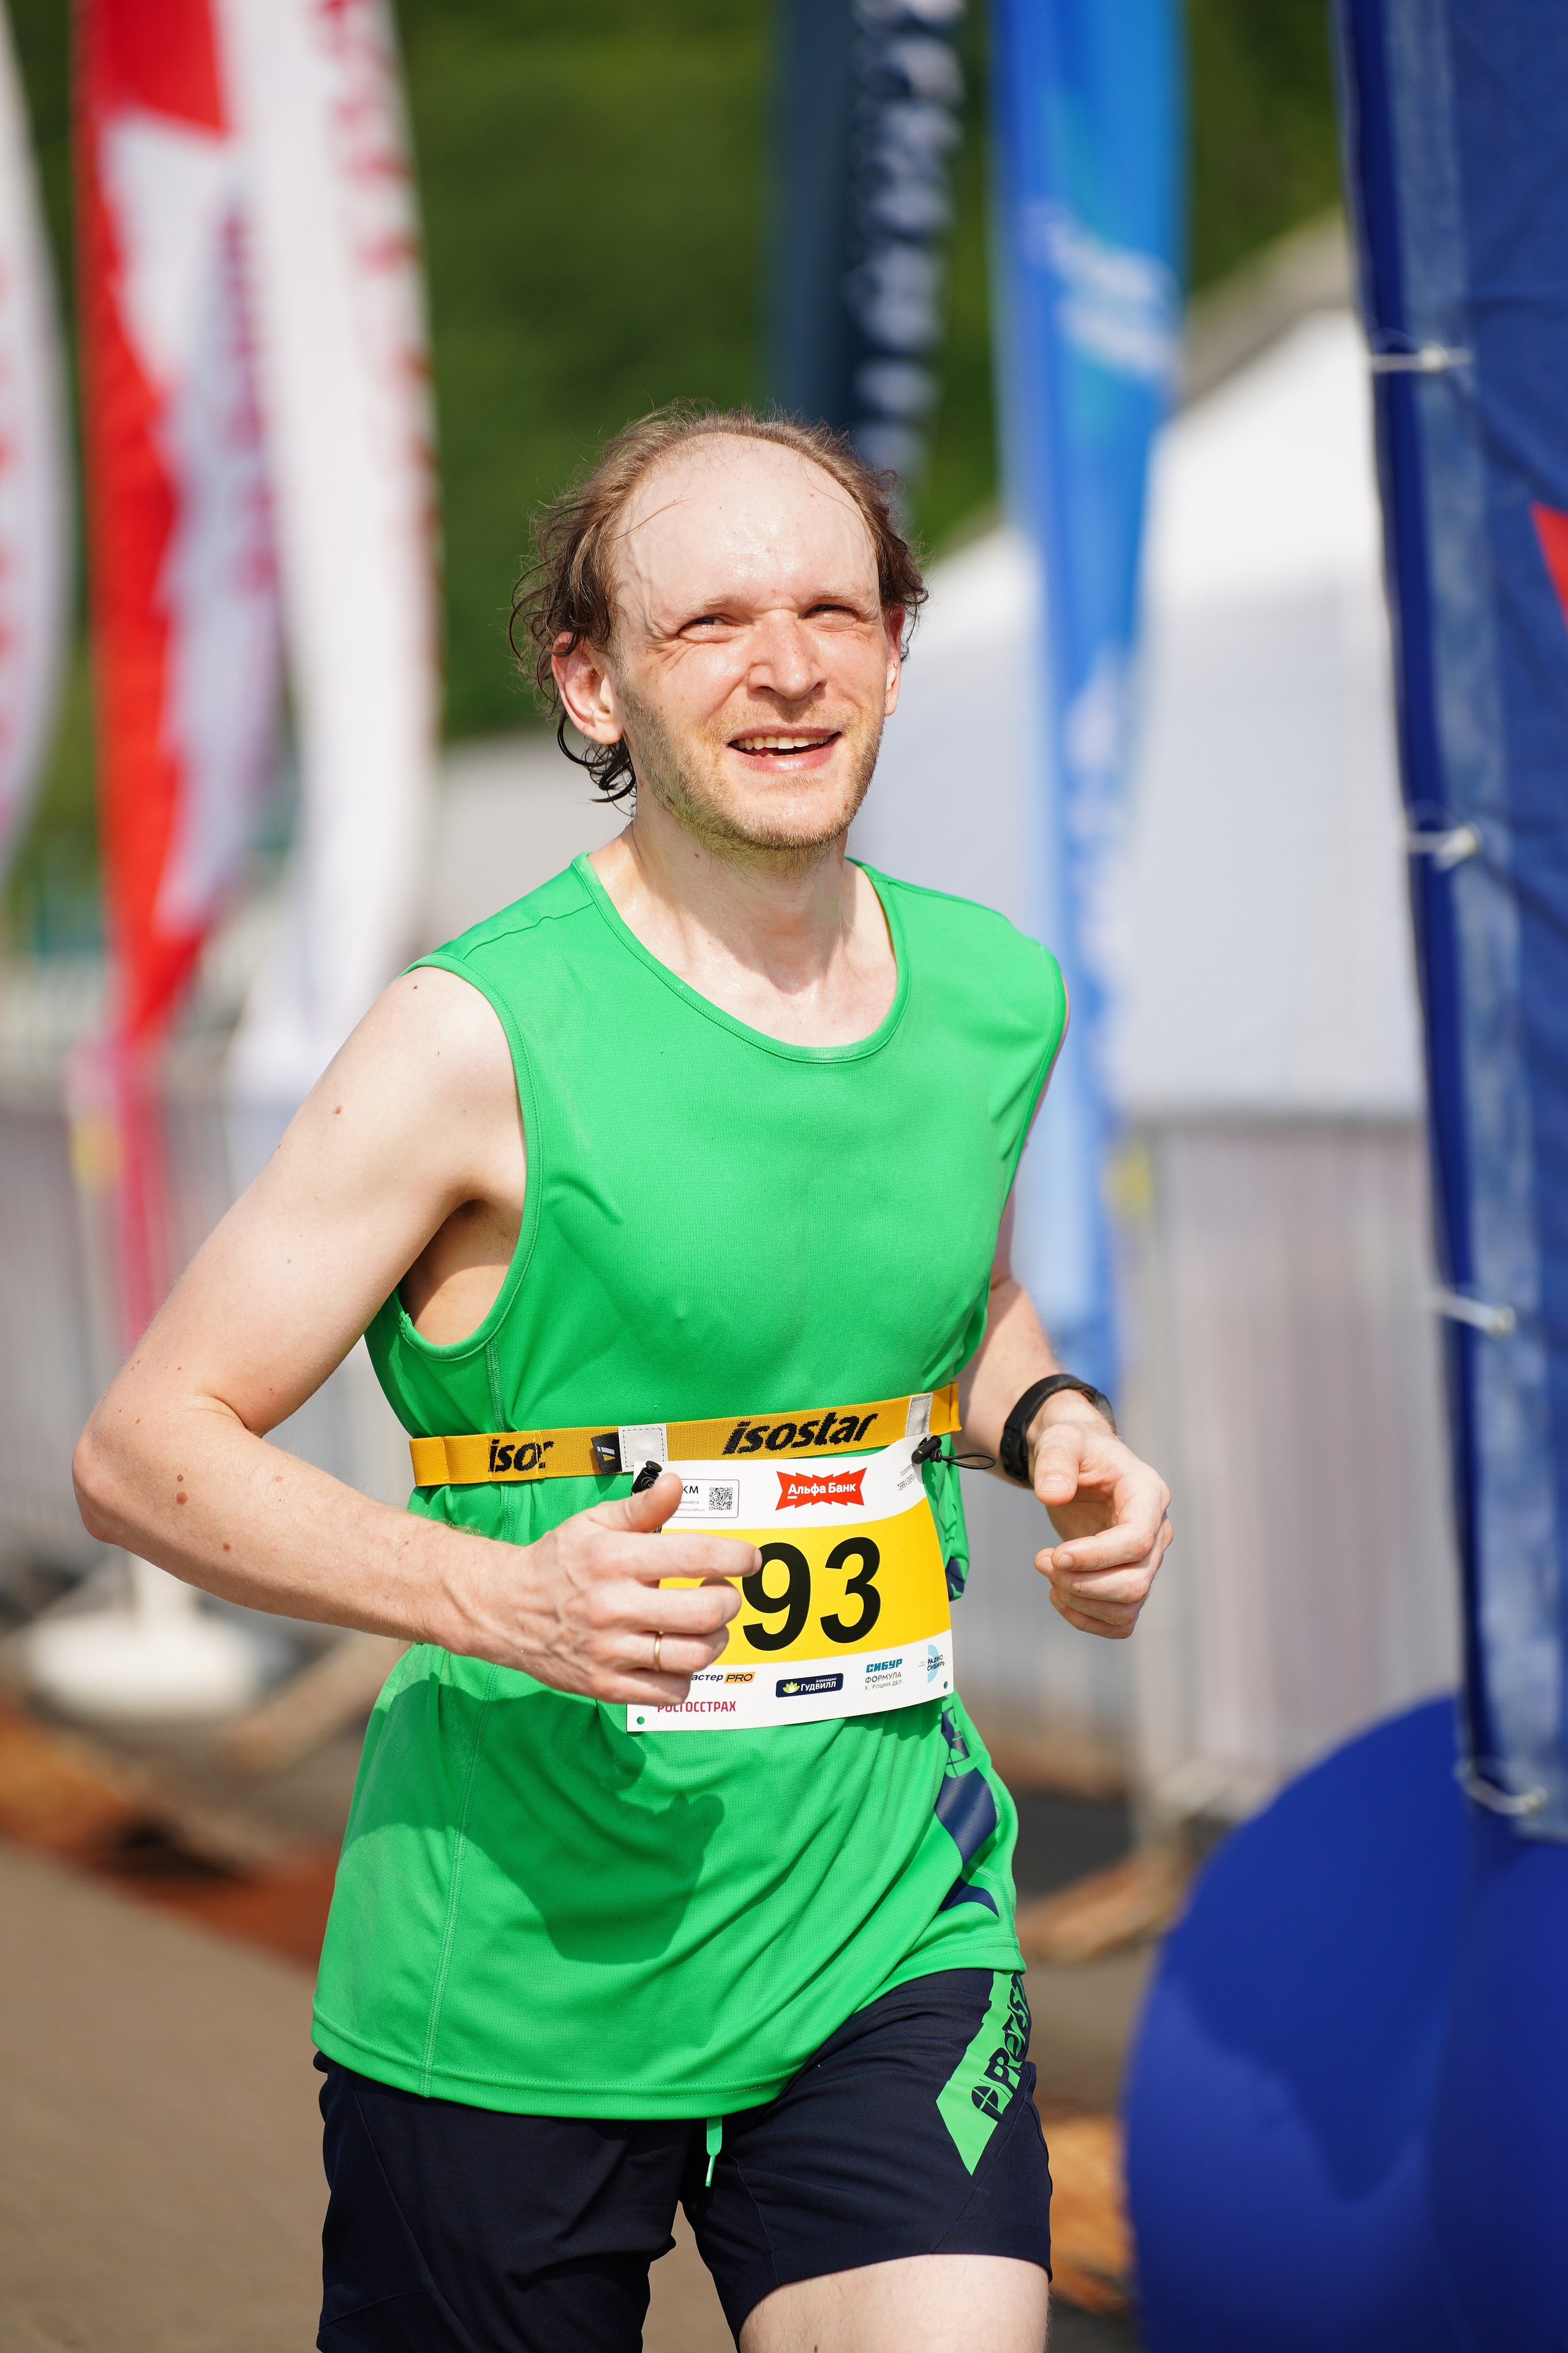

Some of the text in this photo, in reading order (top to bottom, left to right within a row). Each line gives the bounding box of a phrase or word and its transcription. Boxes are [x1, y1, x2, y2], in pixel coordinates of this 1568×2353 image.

[722, 1411, 878, 1455] isostar
[787, 1482, 857, 1497] Альфа Банк
[865, 1658, 903, 1673] СИБУР
[927, 1655, 944, 1665] РАДИО
[927, 1661, 946, 1672] СИБИРЬ
[692, 1674, 753, 1682] астер PRO
[865, 1672, 902, 1683] ФОРМУЛА
[864, 1679, 902, 1691] ХОРОШИХ ДЕЛ
